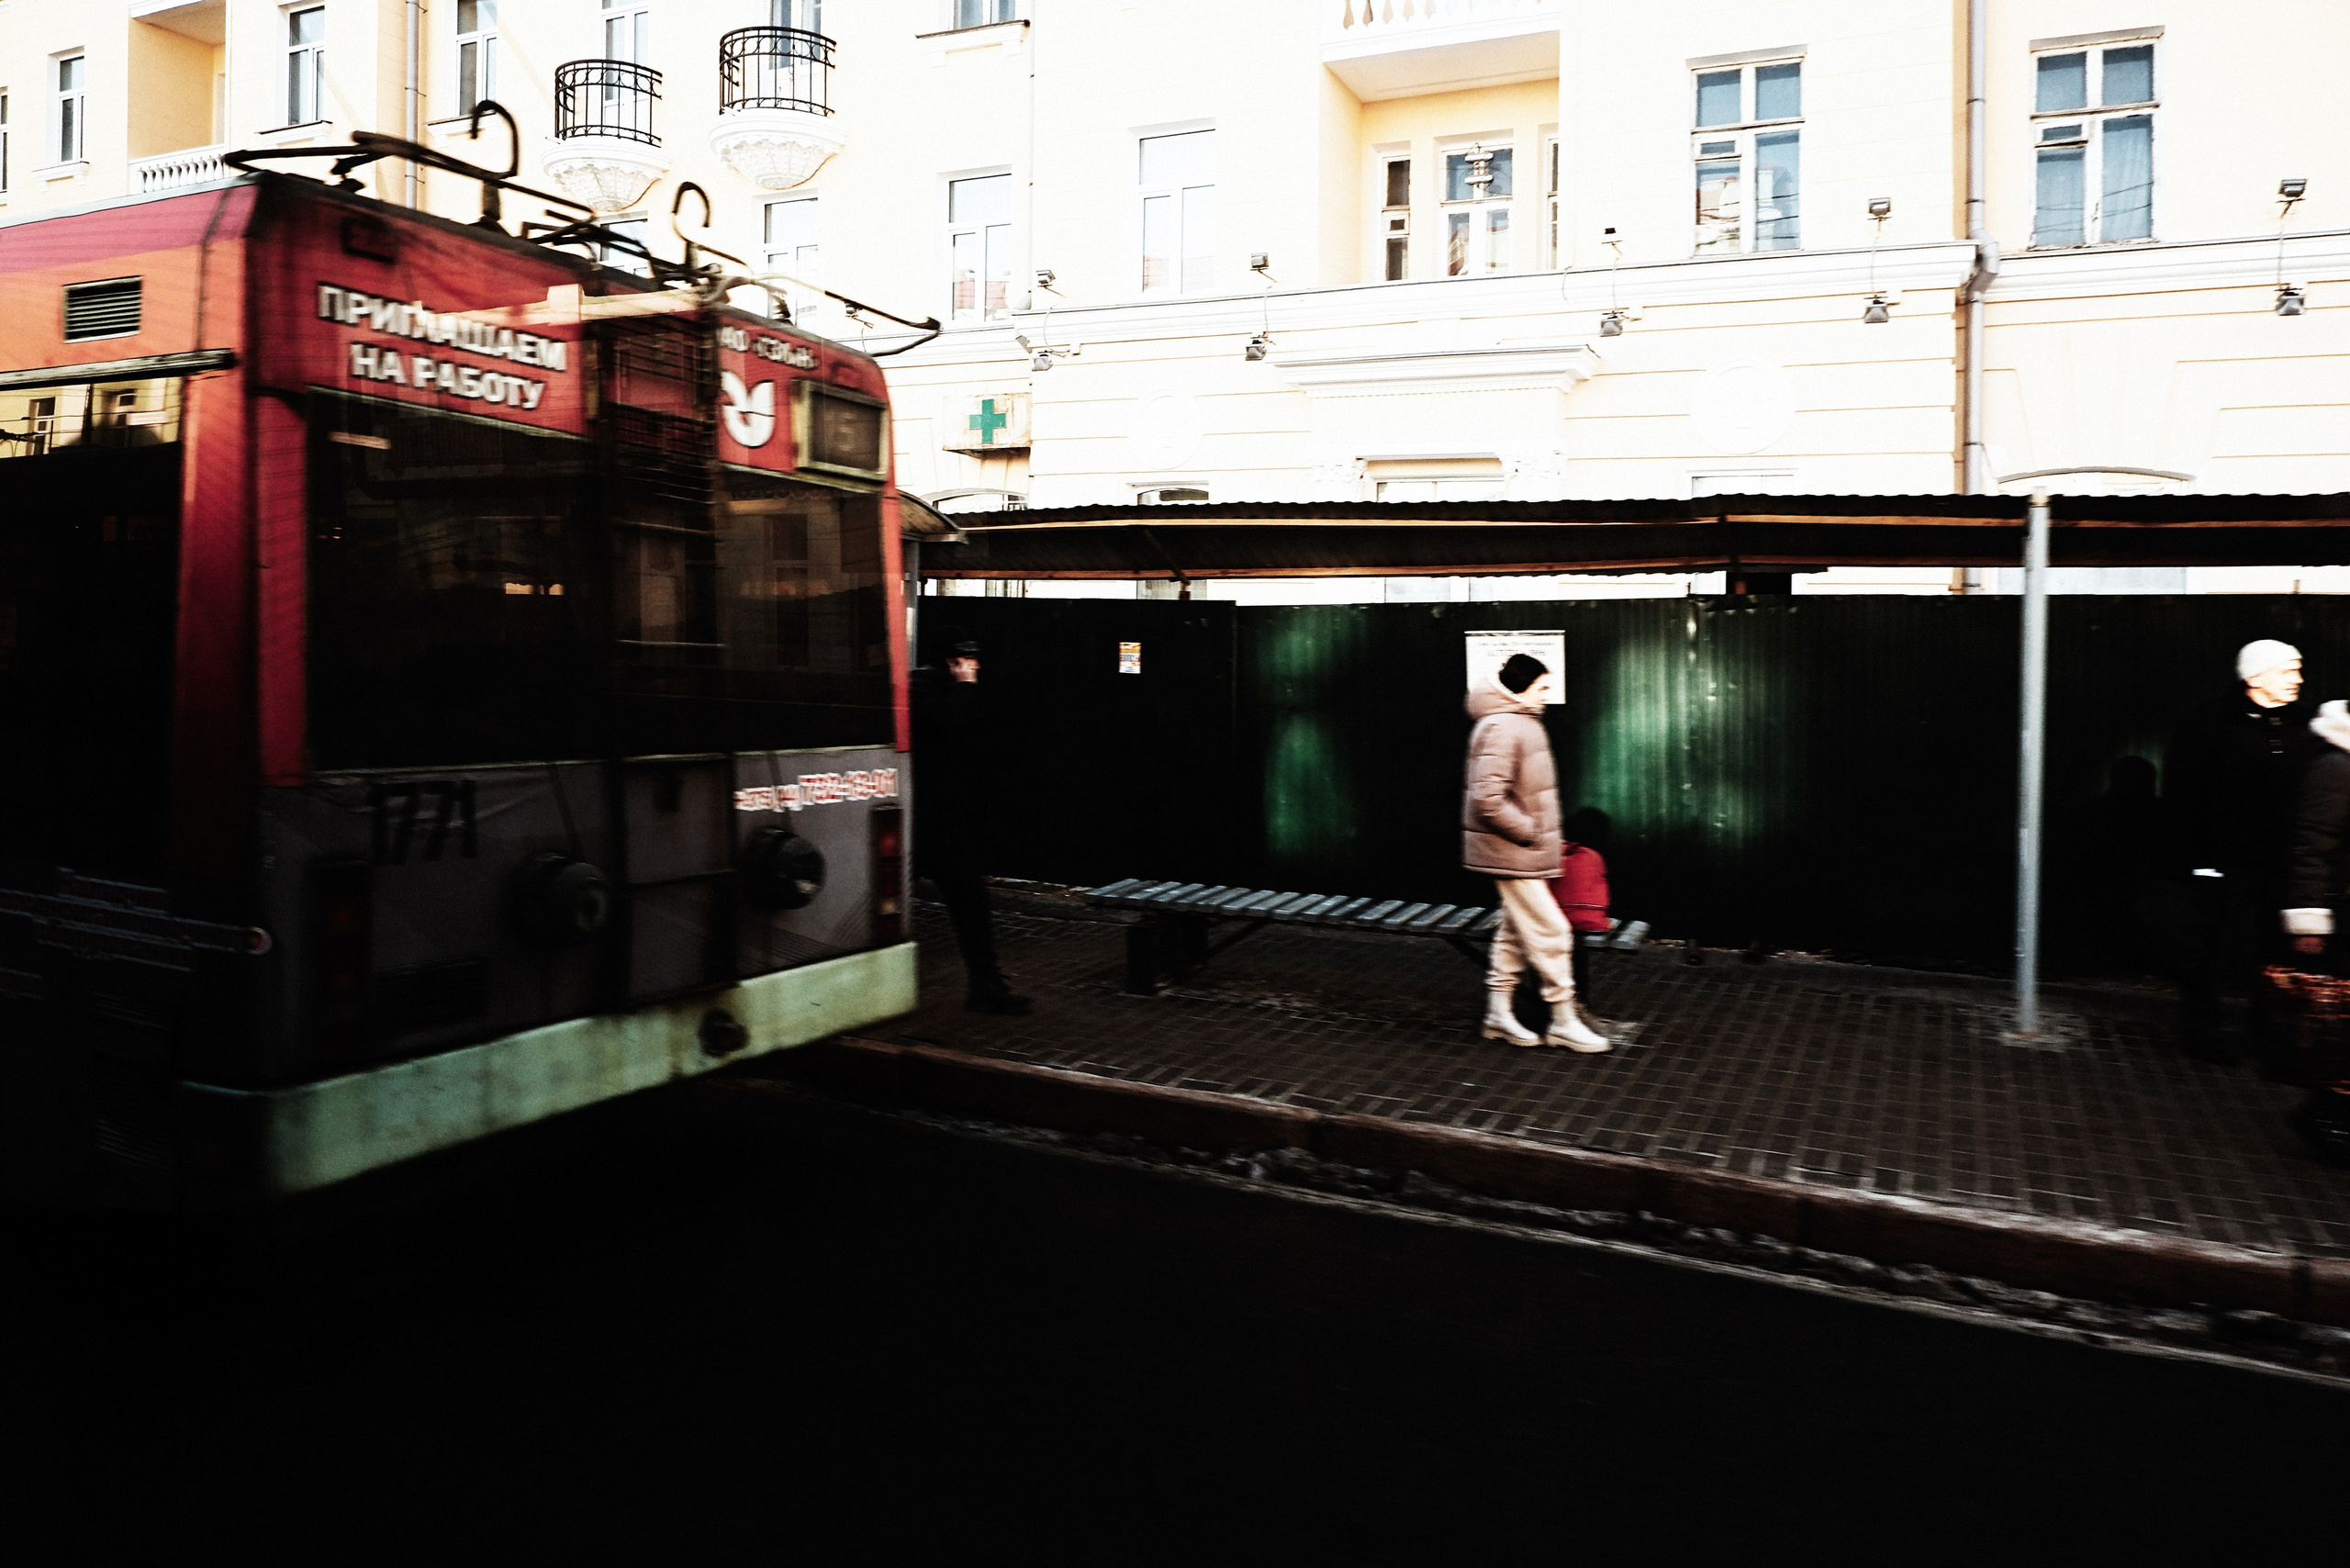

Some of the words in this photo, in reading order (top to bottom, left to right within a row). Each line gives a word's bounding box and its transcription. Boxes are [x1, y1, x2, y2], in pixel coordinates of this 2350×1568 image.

[317, 285, 566, 371] ПРИГЛАШАЕМ
[350, 342, 407, 384] НА
[413, 354, 546, 409] РАБОТУ
